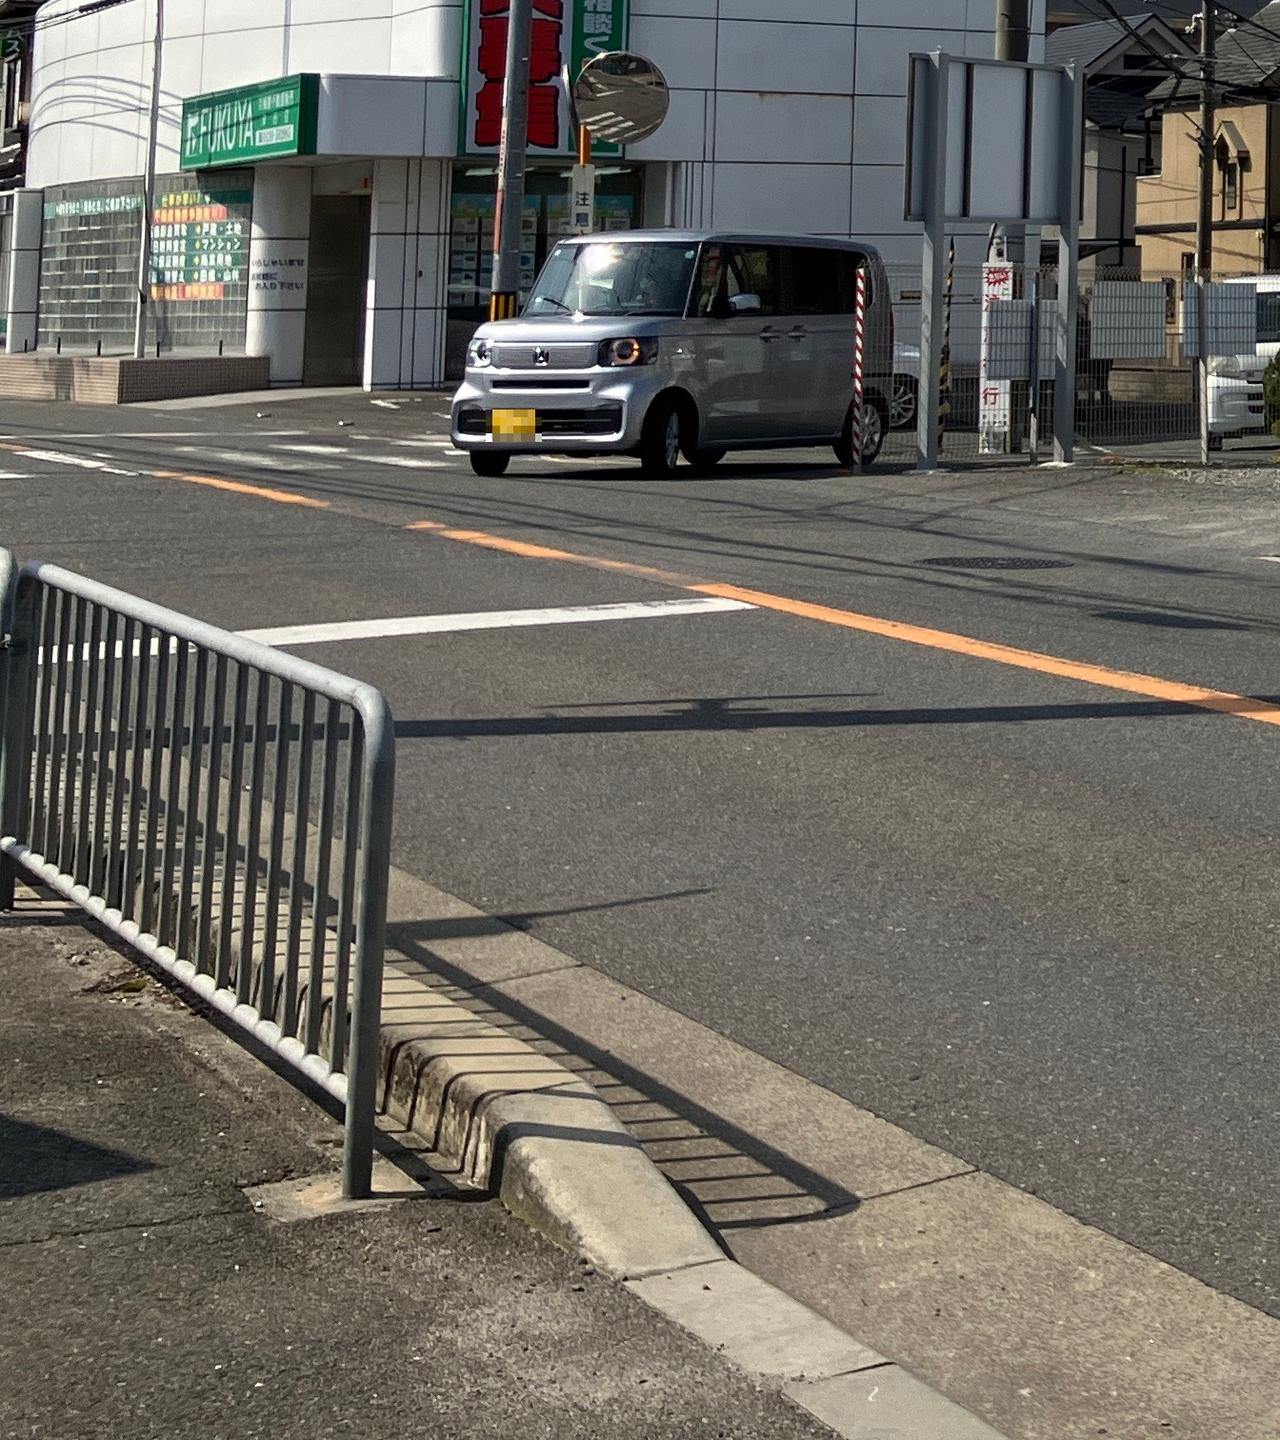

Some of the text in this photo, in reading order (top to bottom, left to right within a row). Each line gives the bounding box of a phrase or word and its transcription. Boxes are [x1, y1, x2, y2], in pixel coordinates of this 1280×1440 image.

[199, 100, 254, 155] FUKUYA
[202, 238, 241, 250] マンション
